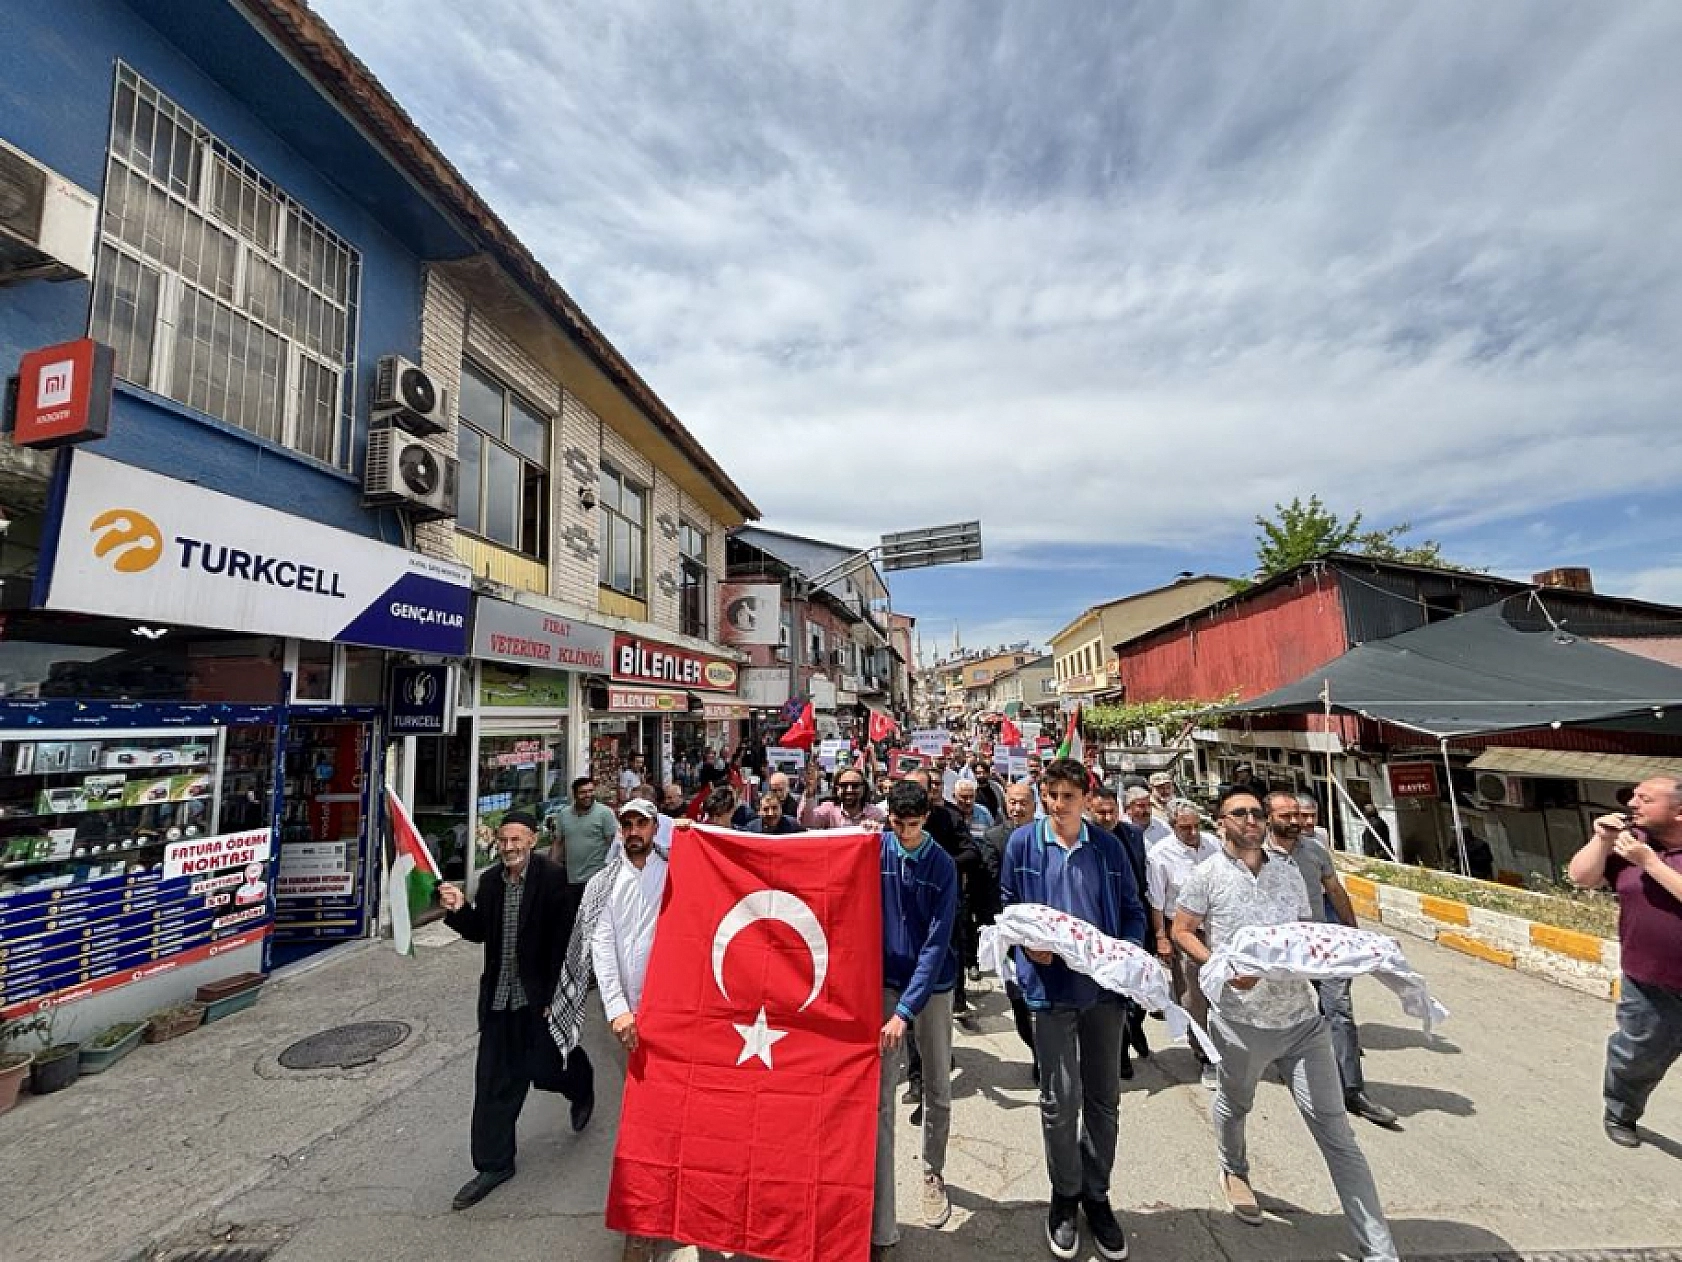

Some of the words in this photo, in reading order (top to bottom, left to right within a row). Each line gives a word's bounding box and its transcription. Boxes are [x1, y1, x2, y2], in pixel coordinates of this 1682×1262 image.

[174, 536, 347, 599] TURKCELL
[390, 602, 464, 628] GENÇAYLAR
[619, 640, 702, 684] BİLENLER
[394, 715, 441, 728] TURKCELL
[171, 840, 222, 862] FATURA
[226, 834, 268, 851] ÖDEME
[182, 848, 256, 874] NOKTASI
